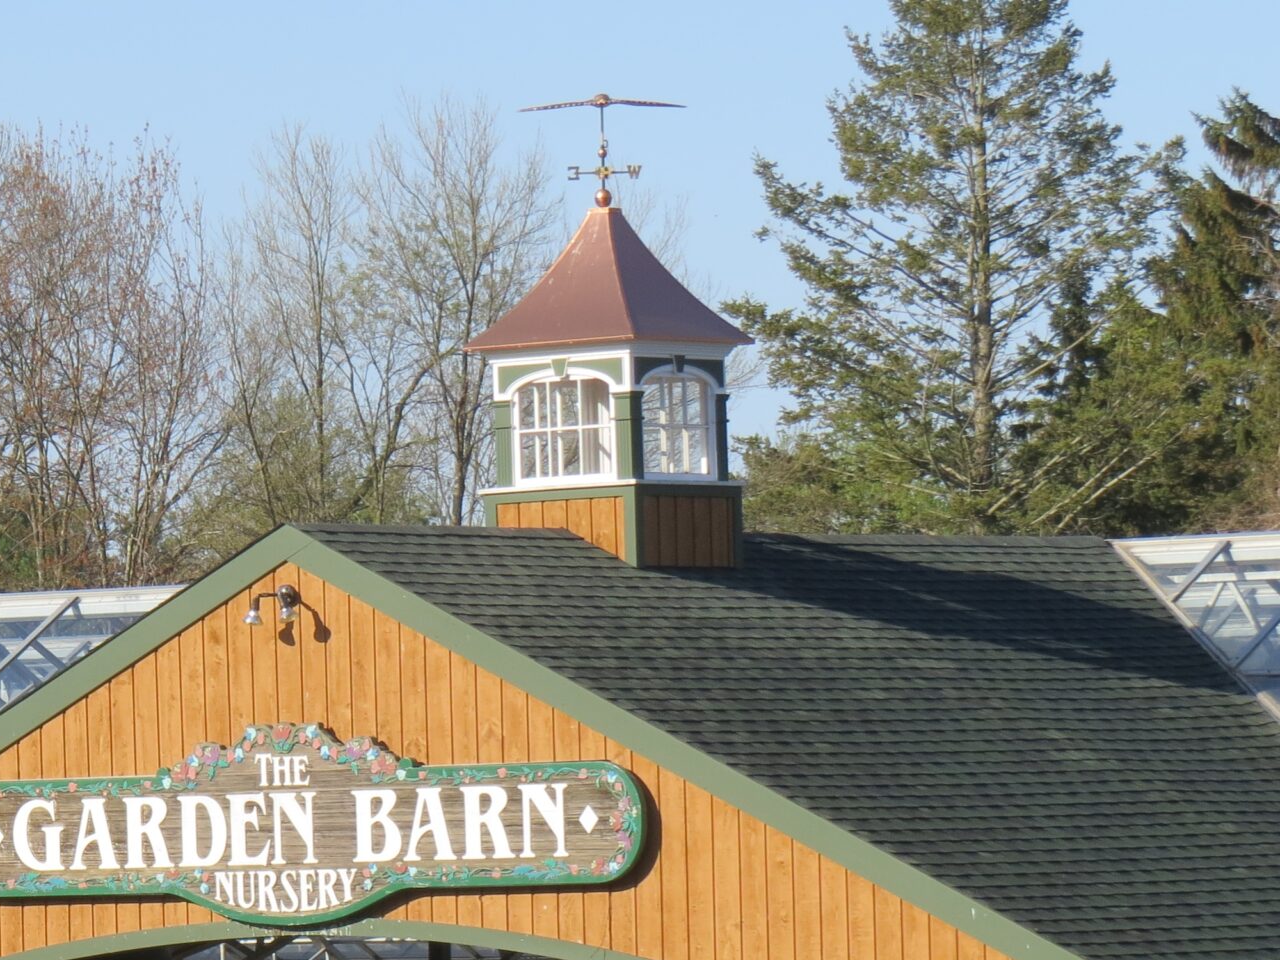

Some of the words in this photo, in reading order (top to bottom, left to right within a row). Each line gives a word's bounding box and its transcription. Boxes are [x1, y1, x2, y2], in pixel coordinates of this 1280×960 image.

[255, 752, 310, 786] THE
[13, 791, 318, 870] GARDEN
[351, 783, 569, 862] BARN
[214, 868, 357, 912] NURSERY
